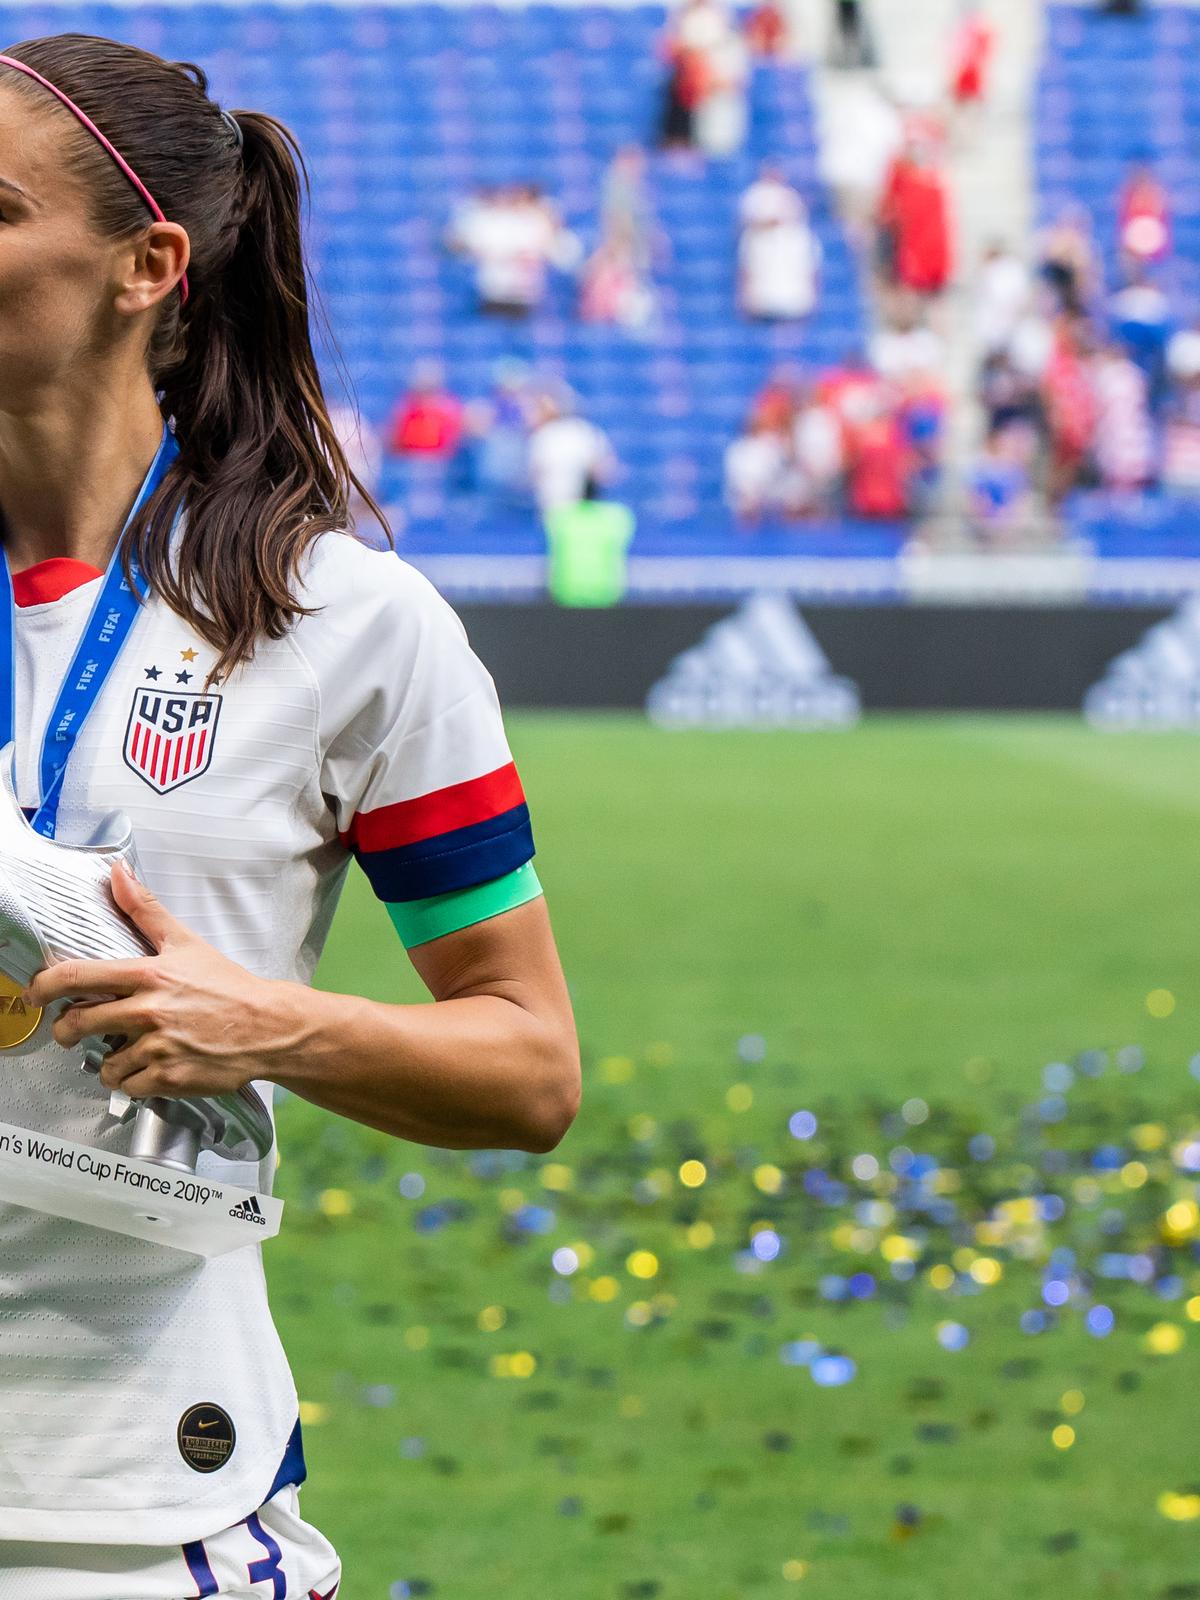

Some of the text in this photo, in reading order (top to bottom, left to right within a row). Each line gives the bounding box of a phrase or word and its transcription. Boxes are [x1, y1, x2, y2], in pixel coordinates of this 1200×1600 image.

[138, 695, 213, 734] USA
[27, 1138, 75, 1169] World
[76, 1153, 112, 1181] Cup
[113, 1163, 172, 1195] France
[228, 1207, 267, 1226] adidas
